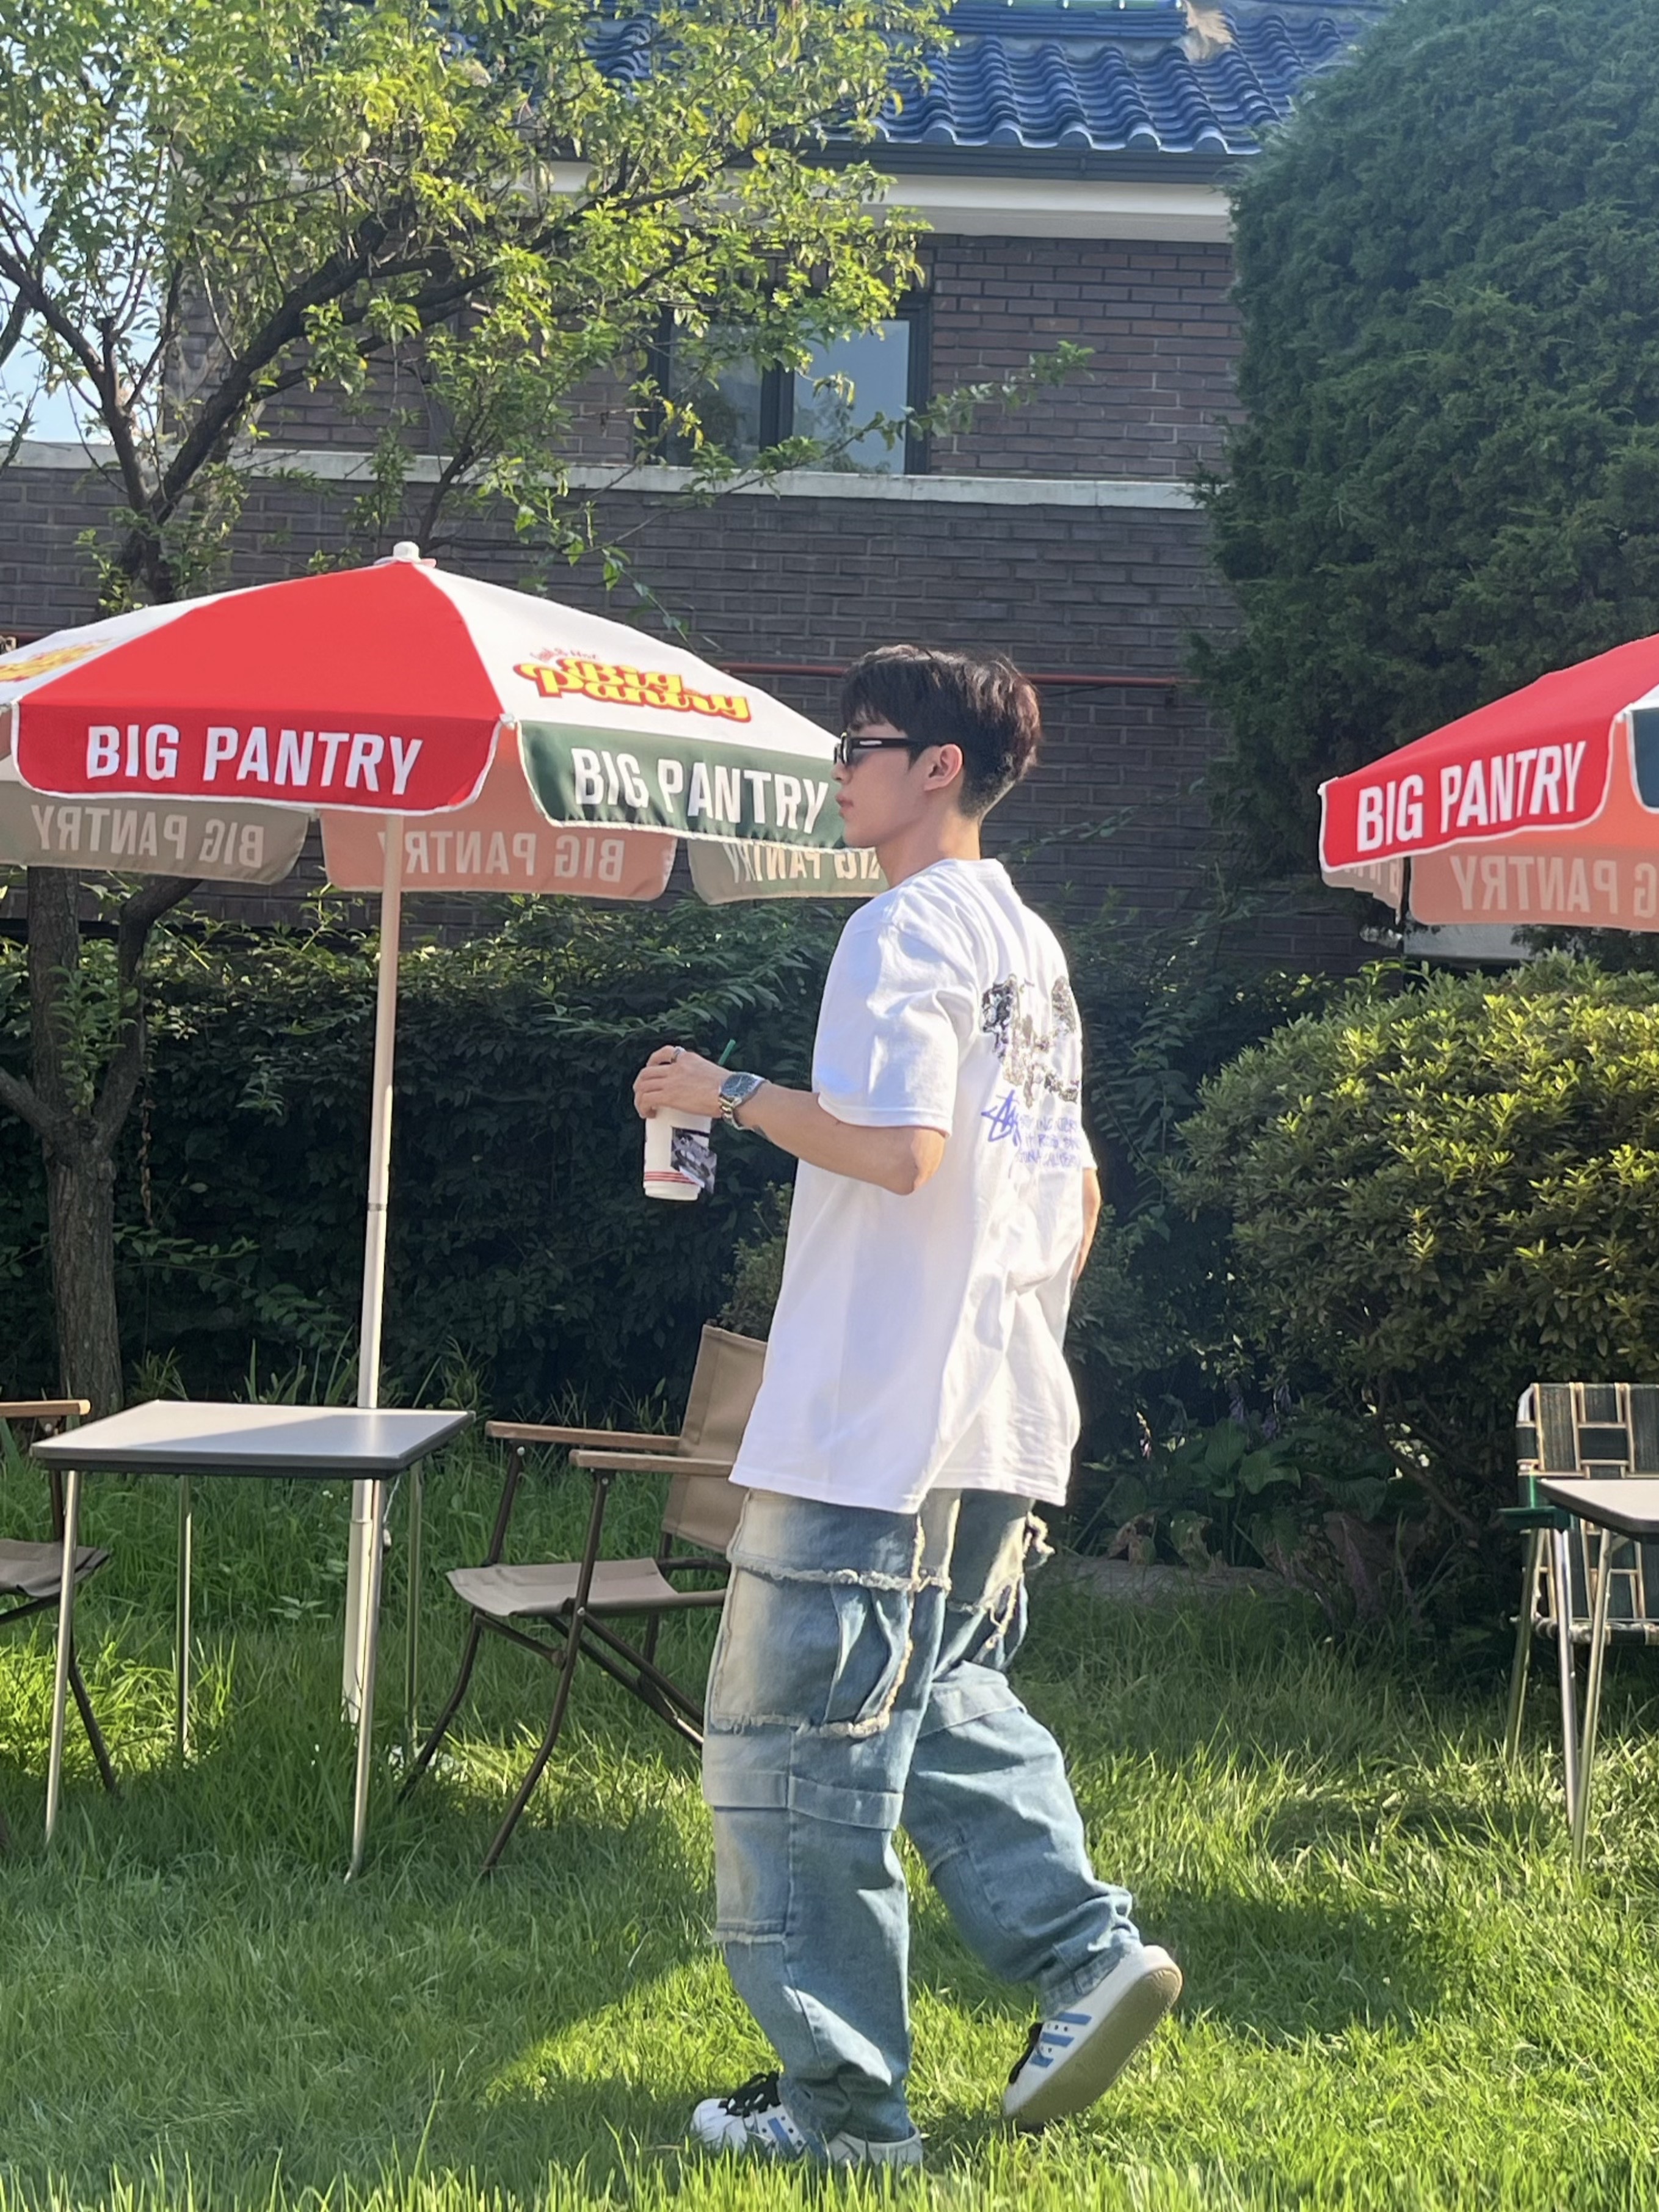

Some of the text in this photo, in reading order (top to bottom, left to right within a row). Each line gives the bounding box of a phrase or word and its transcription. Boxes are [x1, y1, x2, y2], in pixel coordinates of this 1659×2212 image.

[556, 658, 683, 693] Big
[87, 724, 423, 795] BIG PANTRY
[571, 748, 829, 834] BIG PANTRY
[1357, 740, 1586, 853] BIG PANTRY
